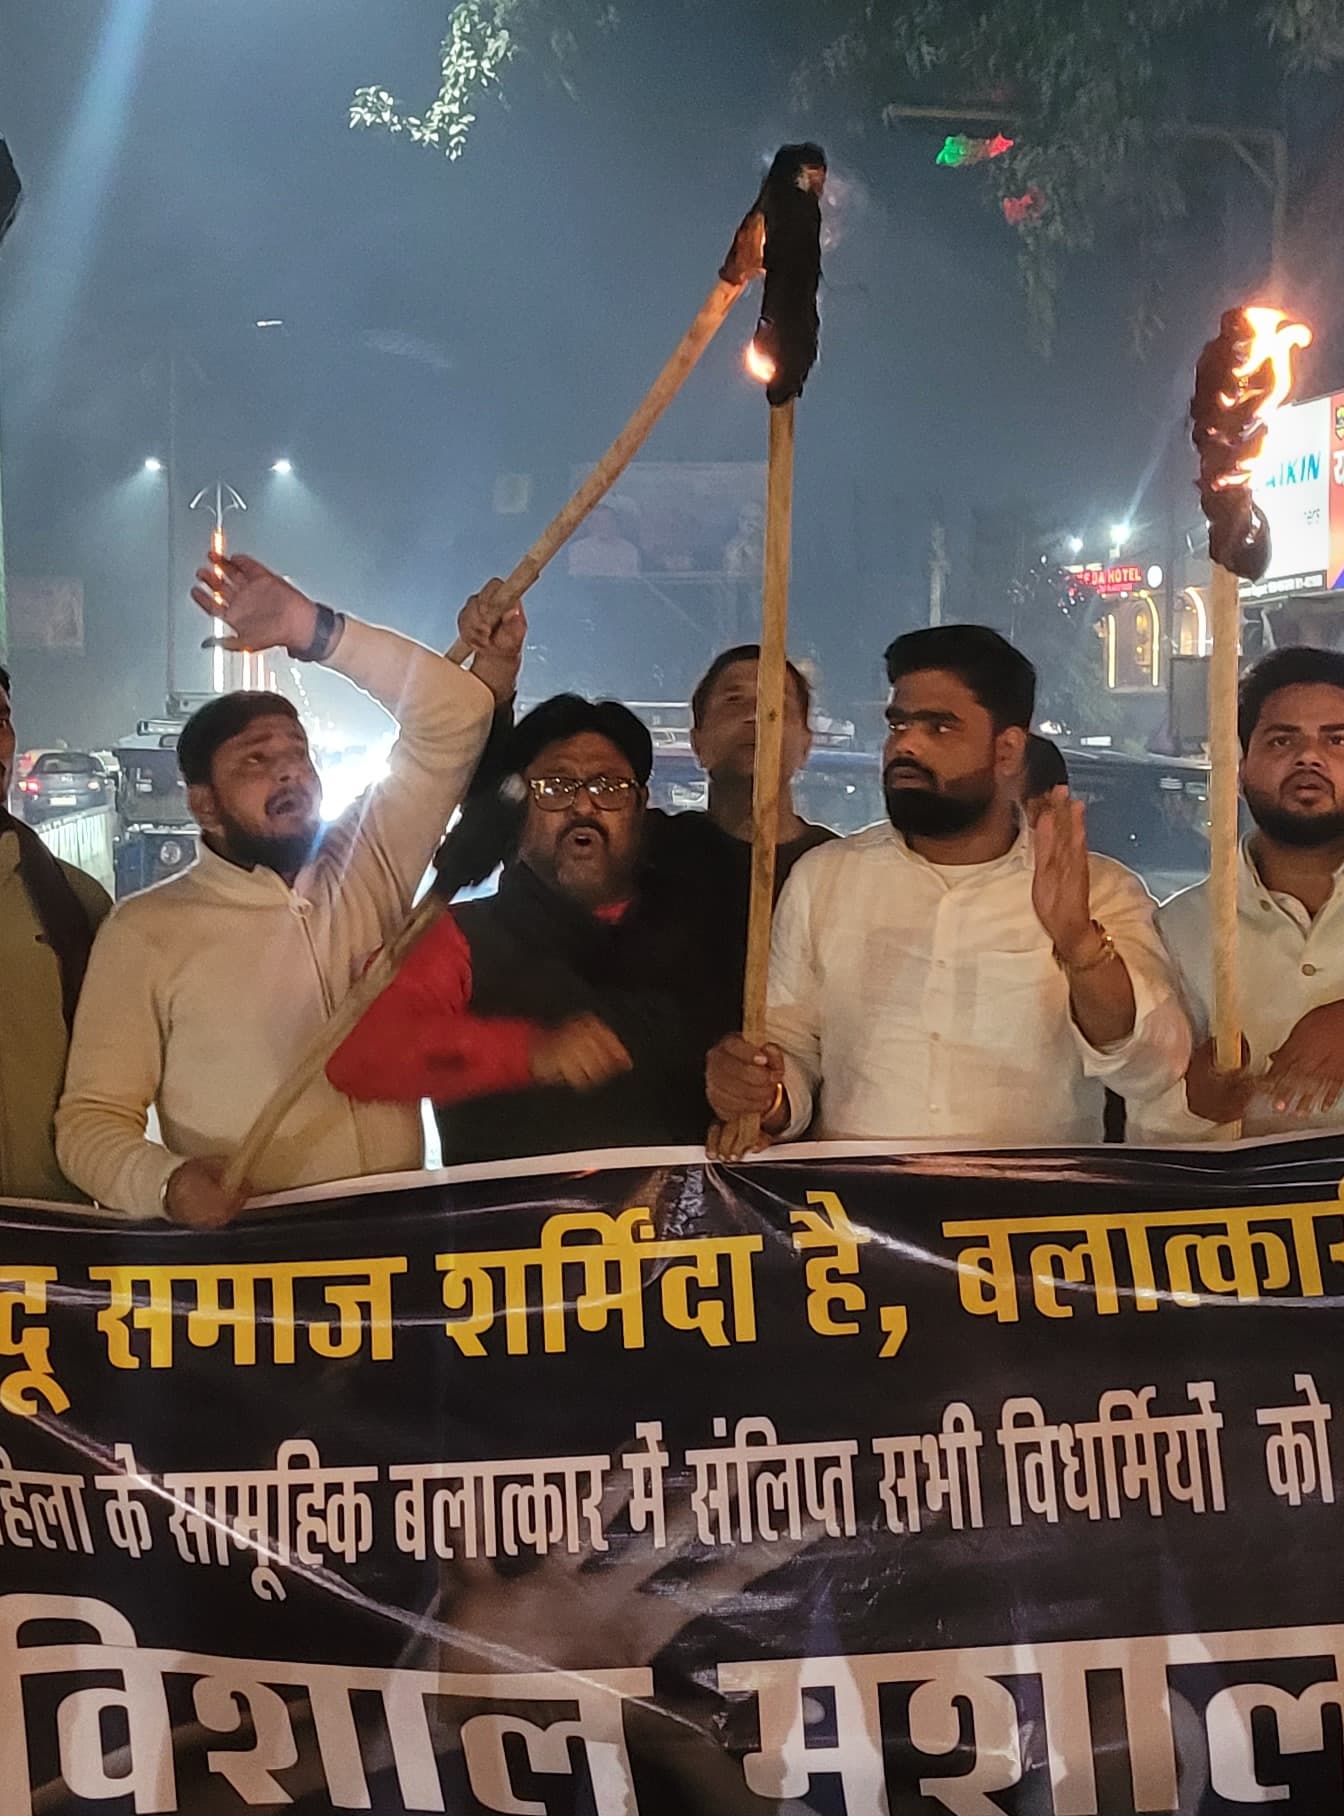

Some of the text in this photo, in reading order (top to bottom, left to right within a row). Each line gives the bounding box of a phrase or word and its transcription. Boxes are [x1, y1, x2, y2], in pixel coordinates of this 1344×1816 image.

[1107, 567, 1143, 584] HOTEL
[88, 1257, 407, 1369] समाज
[435, 1206, 763, 1357] शर्मिंदा
[95, 1443, 157, 1558] के
[163, 1439, 379, 1602] सामूहिक
[389, 1454, 610, 1561] बलात्कार
[622, 1421, 669, 1549] में
[686, 1416, 859, 1547] संलिप्त
[873, 1402, 984, 1534] सभी
[997, 1380, 1226, 1527] विधर्मियों
[1257, 1373, 1335, 1507] को
